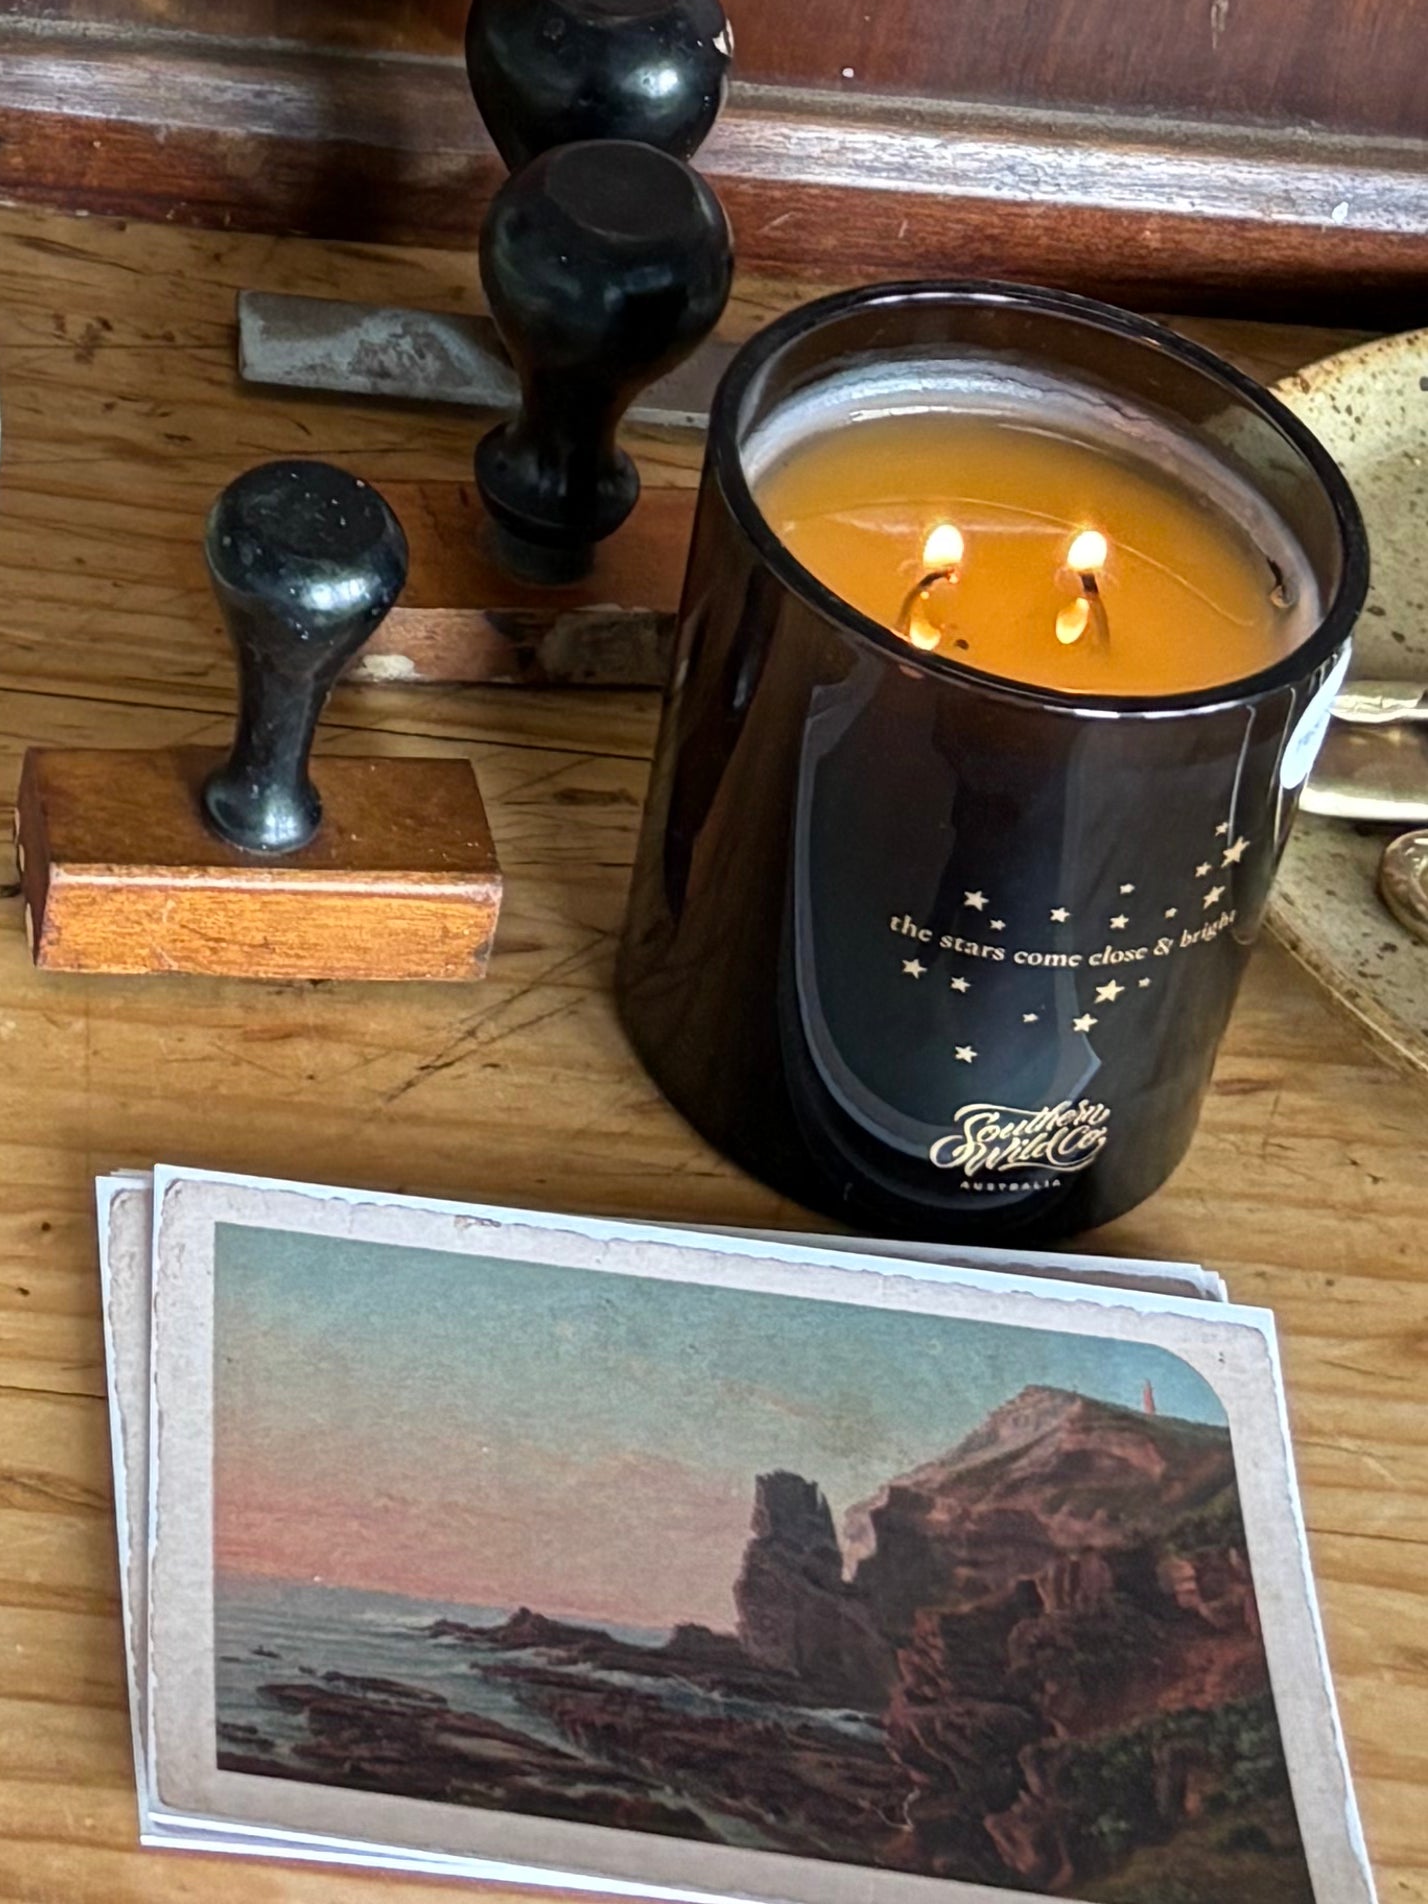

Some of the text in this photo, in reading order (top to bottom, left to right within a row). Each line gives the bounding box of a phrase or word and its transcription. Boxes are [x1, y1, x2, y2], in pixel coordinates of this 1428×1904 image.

[890, 909, 1238, 968] the stars come close & bright
[930, 1099, 1112, 1169] Southern
[964, 1128, 1069, 1177] Wild
[959, 1178, 1062, 1192] AUSTRALIA
